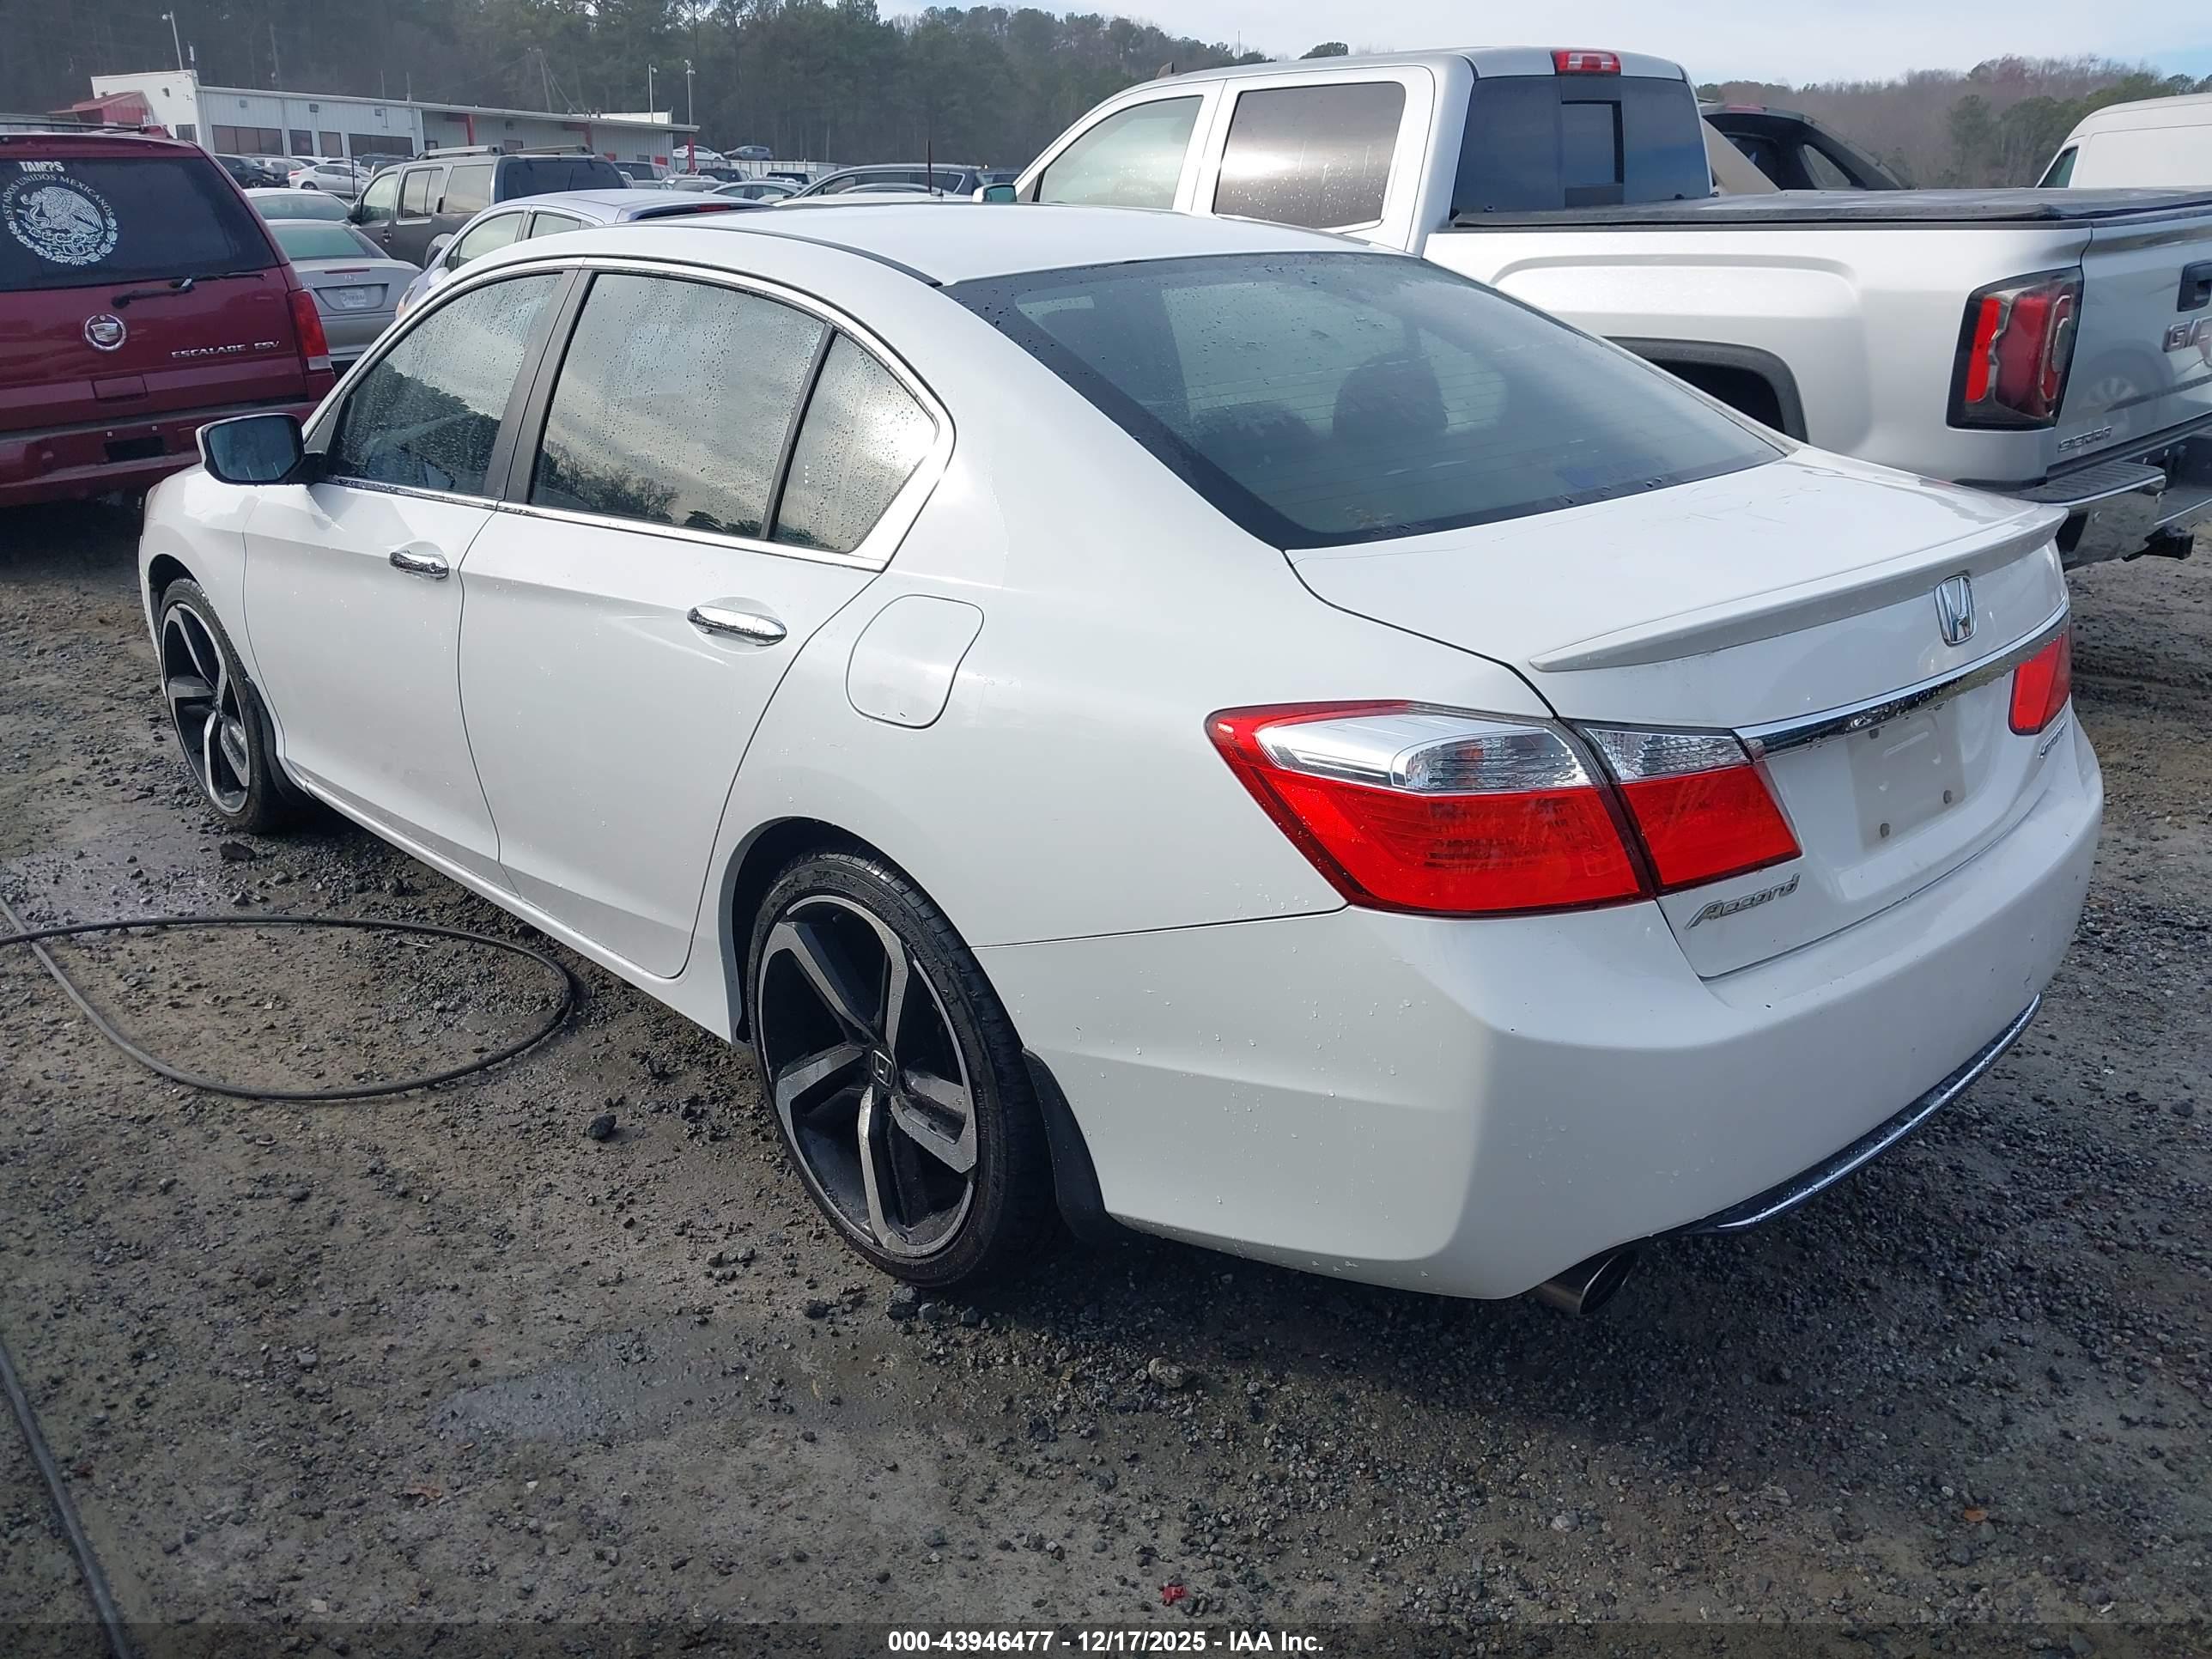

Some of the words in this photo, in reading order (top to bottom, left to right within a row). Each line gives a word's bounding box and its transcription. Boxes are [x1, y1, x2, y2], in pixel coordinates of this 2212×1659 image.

[2, 183, 20, 222] ESTADOS
[15, 173, 57, 186] UNIDOS
[59, 175, 114, 218] MEXICANOS
[170, 343, 247, 359] ESCALADE
[253, 340, 280, 350] ESV
[1684, 872, 1801, 930] Accord
